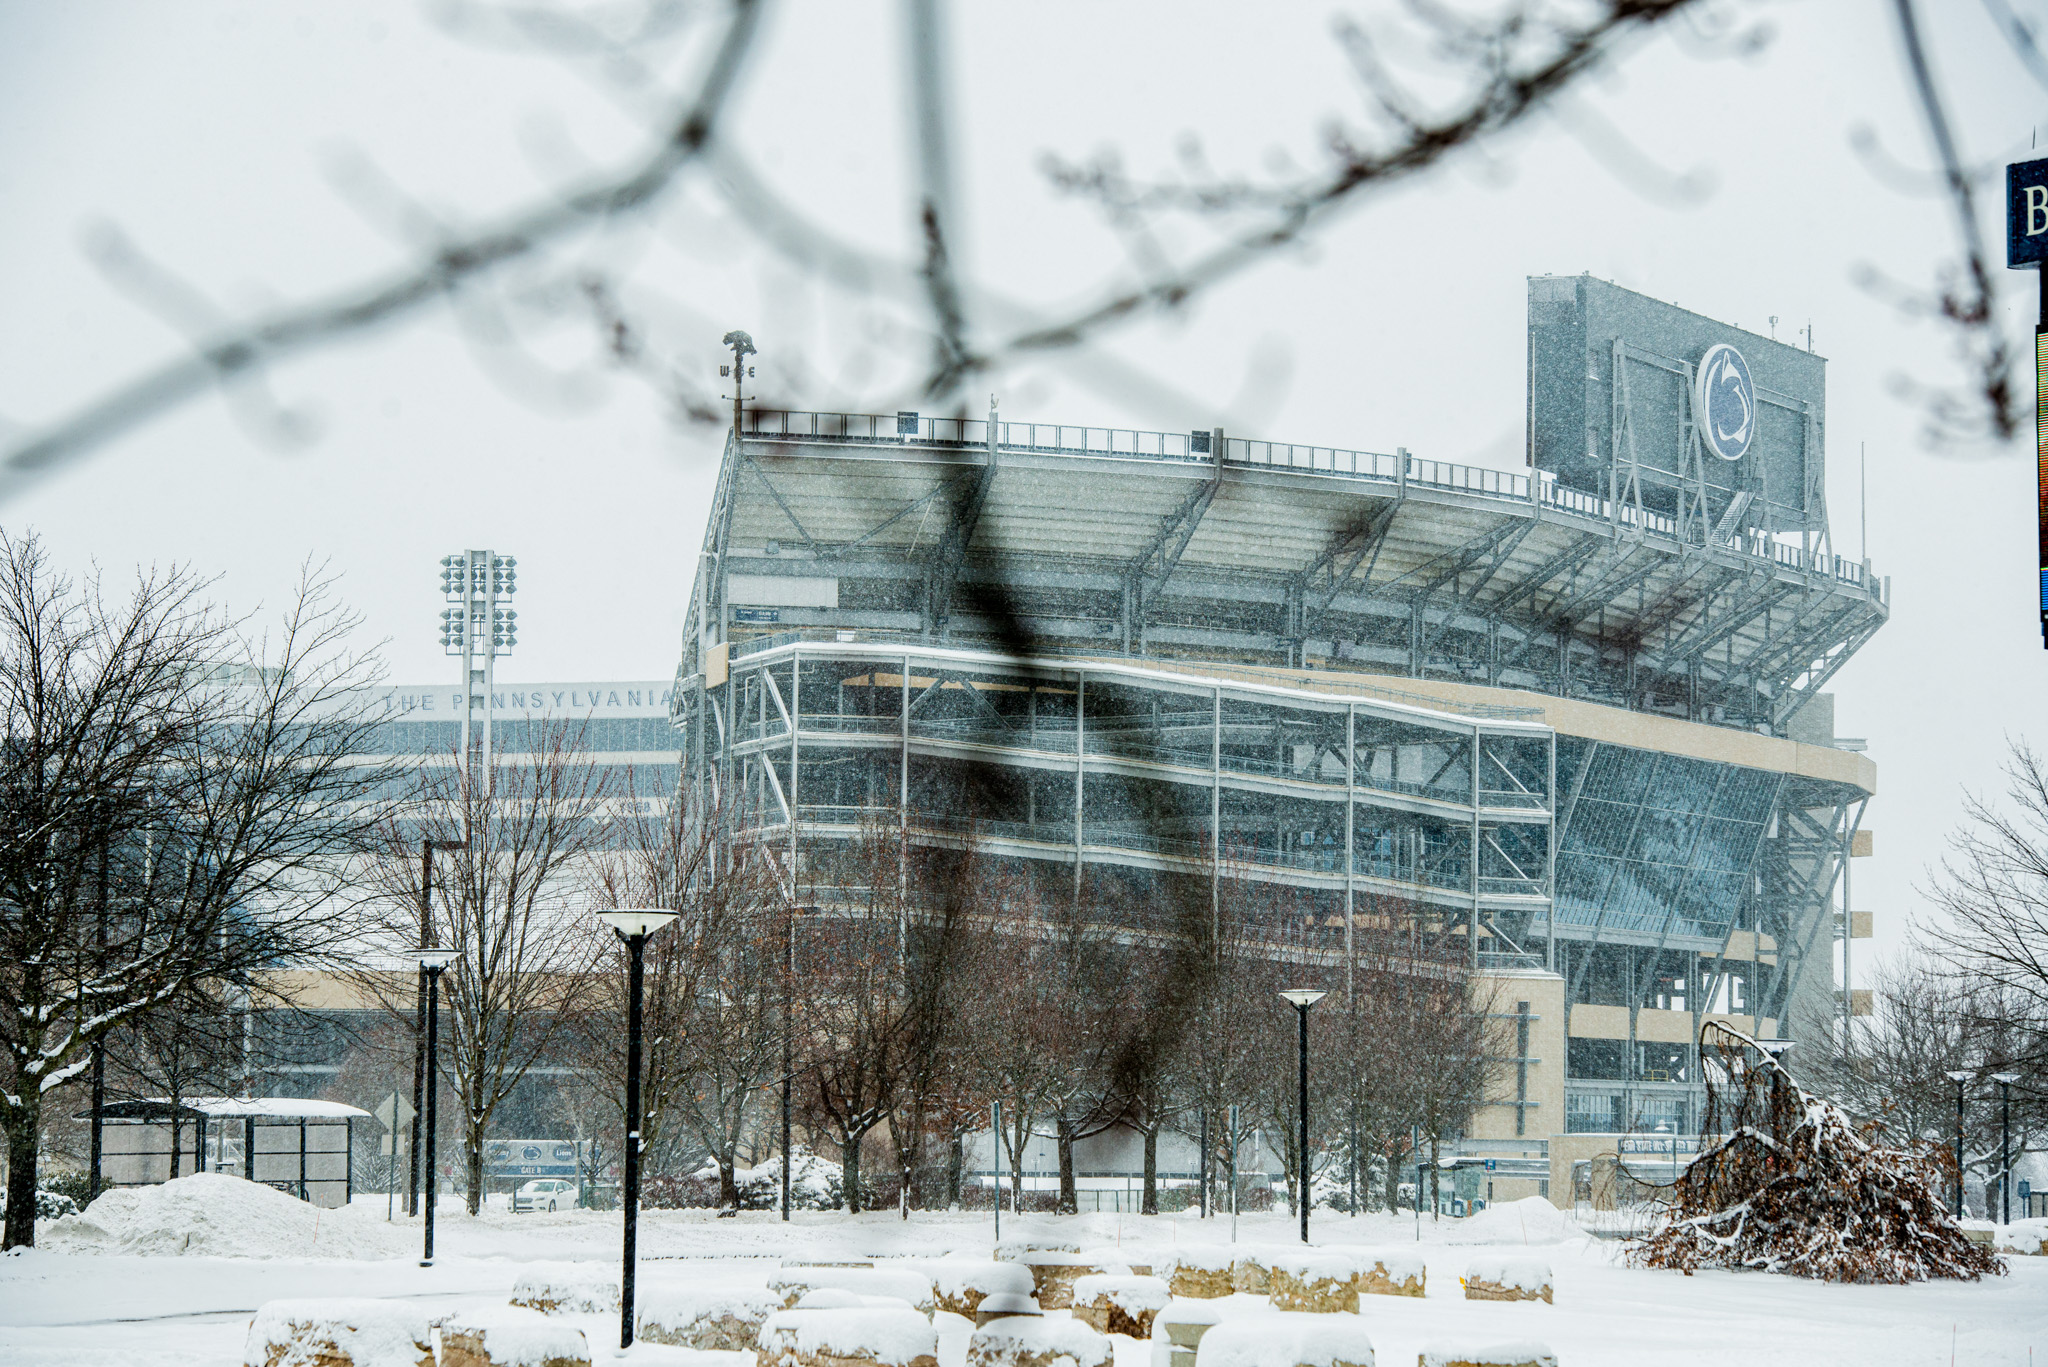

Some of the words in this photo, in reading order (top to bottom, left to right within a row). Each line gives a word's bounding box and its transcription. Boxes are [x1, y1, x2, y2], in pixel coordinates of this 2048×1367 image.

[2023, 185, 2048, 236] B
[720, 366, 729, 377] W
[749, 366, 755, 378] E
[384, 694, 434, 712] THE
[452, 688, 674, 711] PNNSYLVANIA
[520, 1166, 535, 1174] GATE
